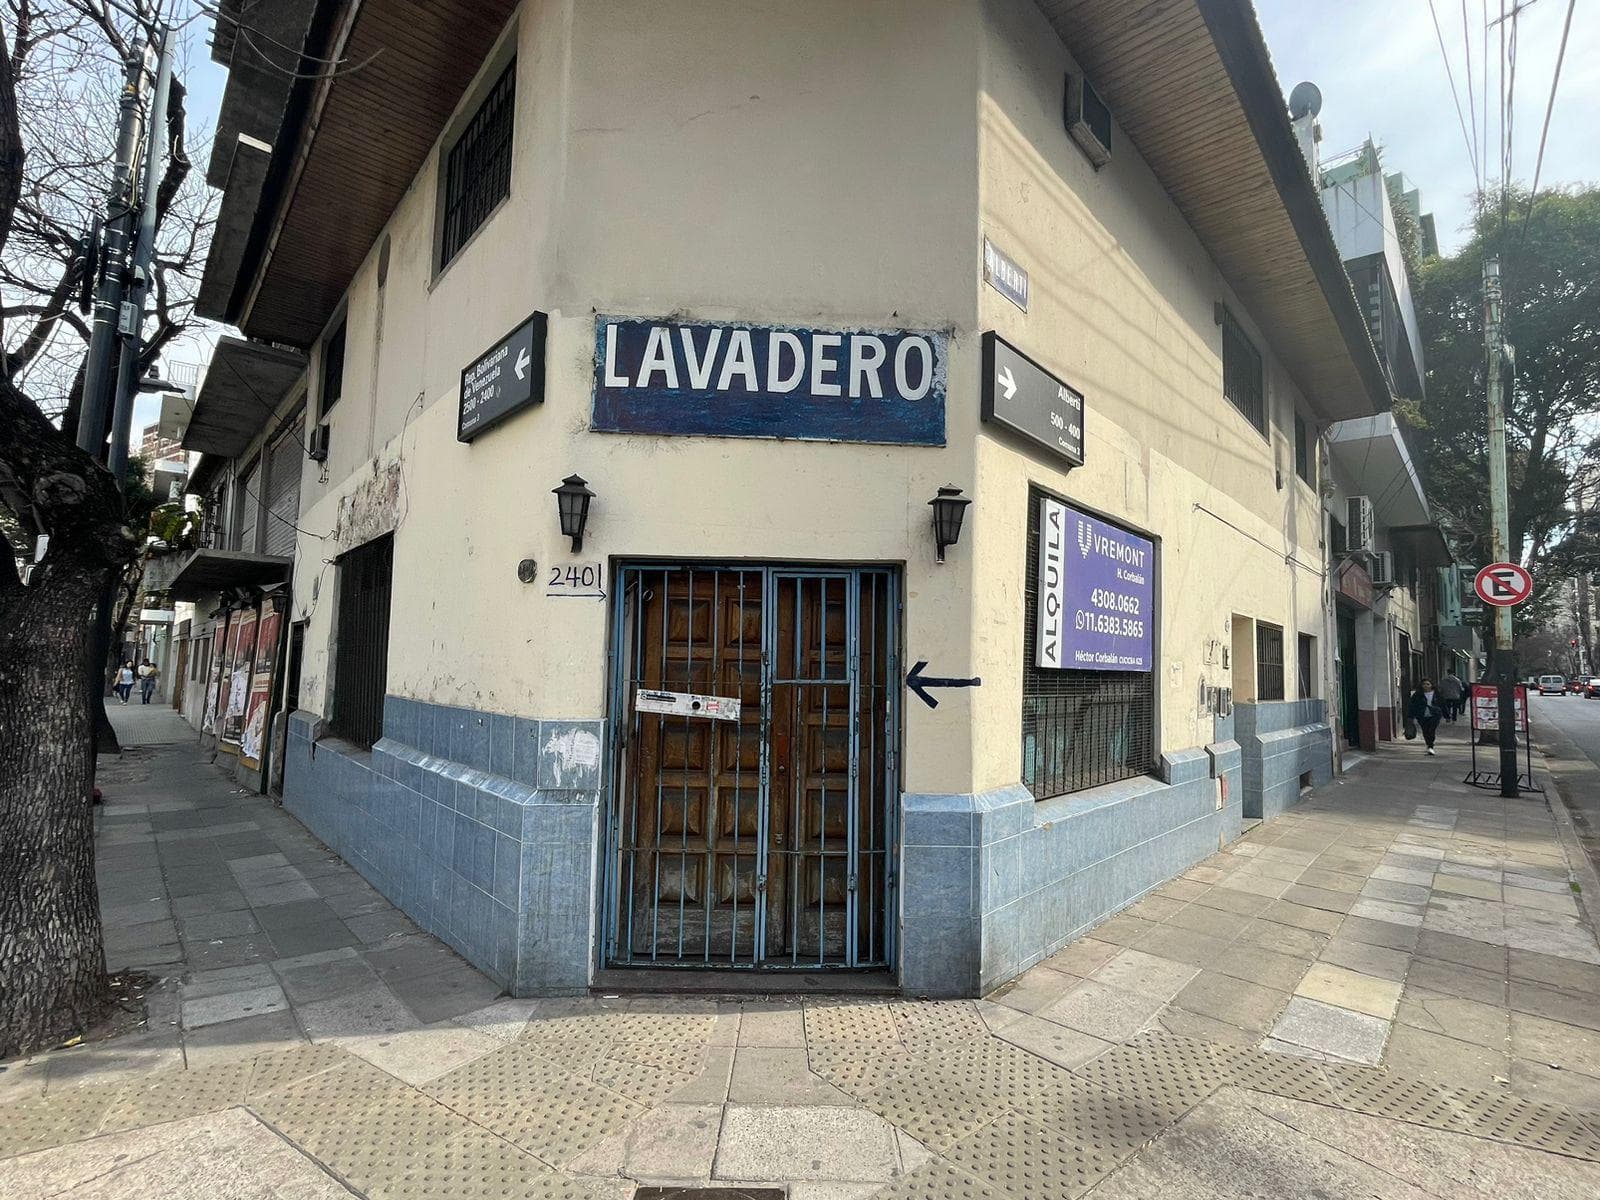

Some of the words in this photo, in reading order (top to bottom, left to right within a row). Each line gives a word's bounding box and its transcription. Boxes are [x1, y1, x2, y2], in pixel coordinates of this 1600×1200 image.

[476, 346, 508, 377] Bolivariana
[604, 324, 933, 401] LAVADERO
[463, 386, 471, 399] de
[471, 365, 501, 393] Venezuela
[480, 384, 494, 404] 2400
[1058, 385, 1081, 411] Alberti
[1050, 411, 1064, 430] 500
[1068, 423, 1081, 440] 400
[1058, 436, 1077, 454] Comuna
[1094, 533, 1145, 568] VREMONT
[549, 563, 601, 588] 2401
[1045, 509, 1061, 662] ALQUILA
[1091, 588, 1139, 615] 4308.0662
[1085, 612, 1144, 638] 11.6383.5865
[1075, 650, 1094, 662] Héctor
[1095, 652, 1118, 663] Corbalán
